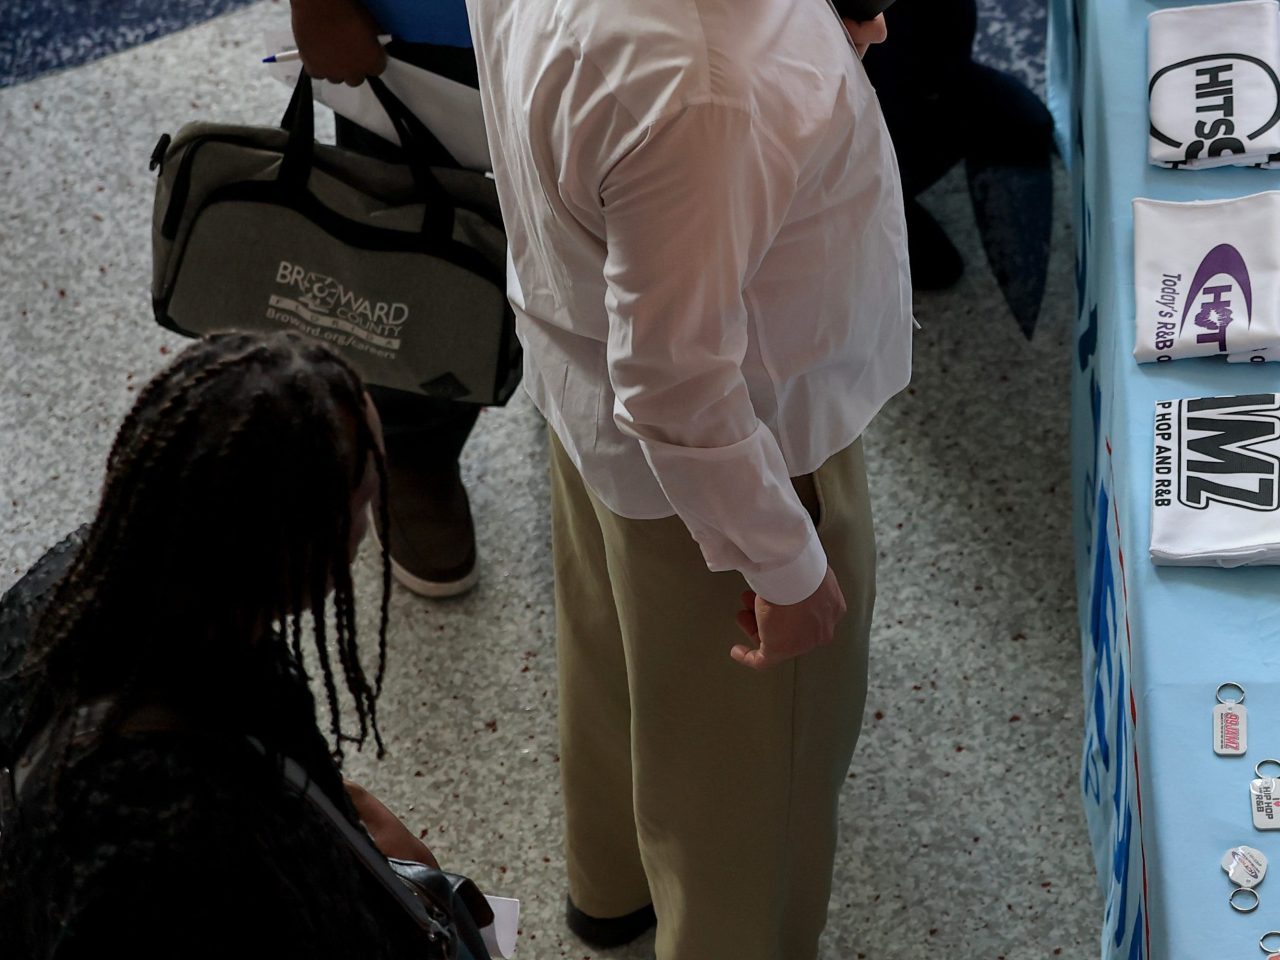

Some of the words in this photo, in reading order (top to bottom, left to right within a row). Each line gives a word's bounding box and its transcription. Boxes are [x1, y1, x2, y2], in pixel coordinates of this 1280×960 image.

[1195, 64, 1235, 139] HITS
[275, 261, 409, 325] BROWARD
[1155, 273, 1182, 319] Today's
[336, 307, 403, 337] COUNTY
[1155, 322, 1176, 351] R&B
[1156, 413, 1172, 441] HOP
[1155, 445, 1172, 475] AND
[1154, 479, 1171, 507] R&B
[1255, 794, 1264, 813] R&B
[1263, 786, 1272, 801] HIP
[1264, 801, 1274, 820] HOP
